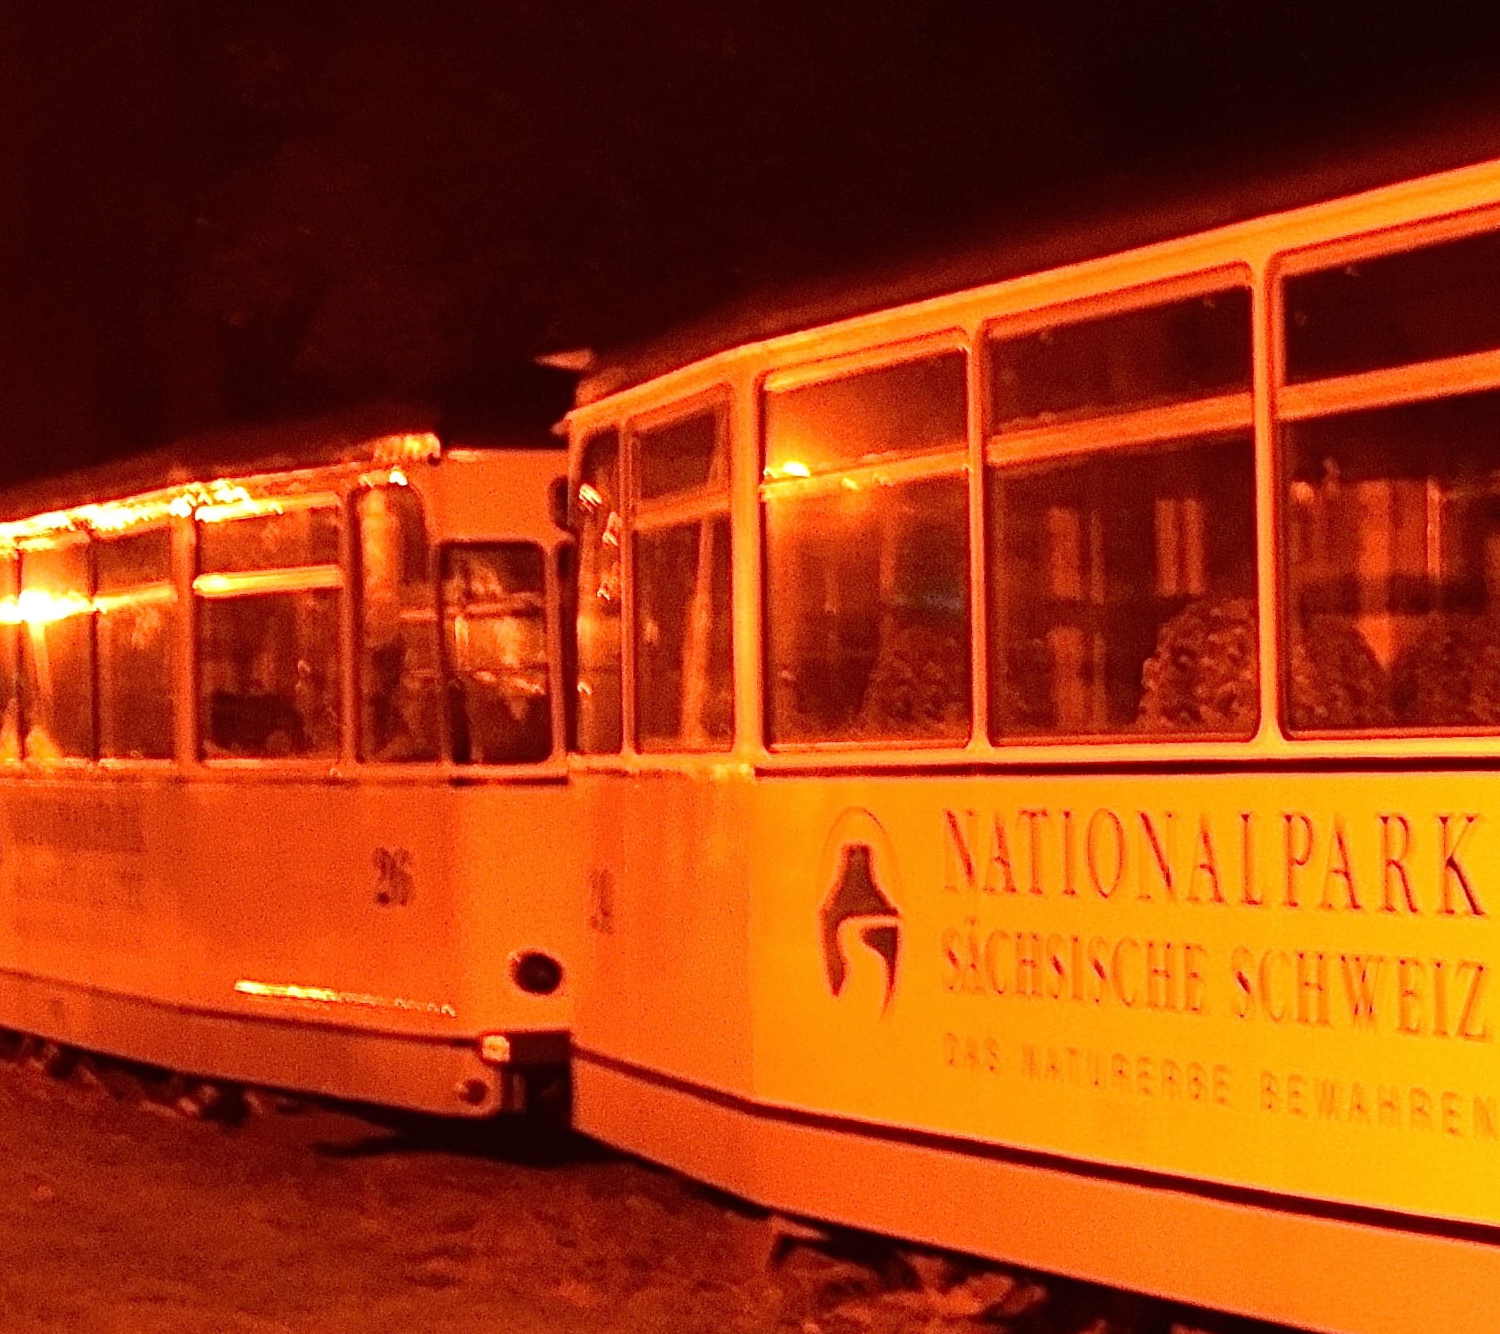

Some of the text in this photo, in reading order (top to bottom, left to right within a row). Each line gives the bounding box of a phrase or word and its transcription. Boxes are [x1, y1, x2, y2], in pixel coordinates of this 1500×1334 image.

[941, 806, 1489, 920] NATIONALPARK
[940, 917, 1493, 1042] SÄCHSISCHE SCHWEIZ
[941, 1030, 1500, 1143] DAS NATURERBE BEWAHREN
